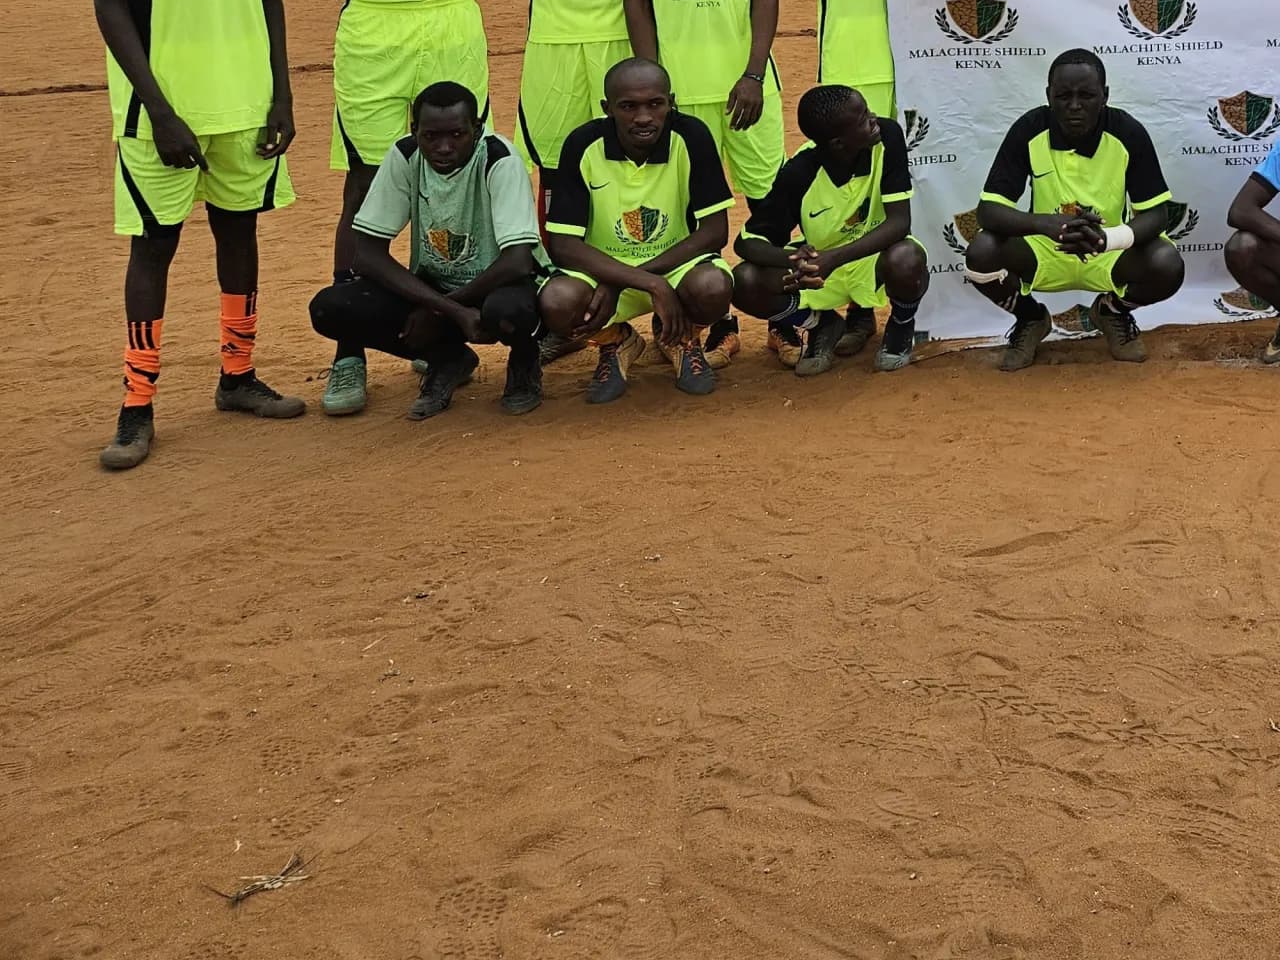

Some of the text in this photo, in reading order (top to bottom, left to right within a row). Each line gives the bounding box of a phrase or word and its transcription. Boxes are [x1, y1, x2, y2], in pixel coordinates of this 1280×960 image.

[909, 47, 1047, 59] MALACHITE SHIELD
[1092, 41, 1223, 55] MALACHITE SHIELD
[955, 60, 1002, 69] KENYA
[1137, 56, 1181, 66] KENYA
[1181, 144, 1260, 155] MALACHITE
[907, 154, 957, 167] SHIELD
[1177, 243, 1224, 252] SHIELD
